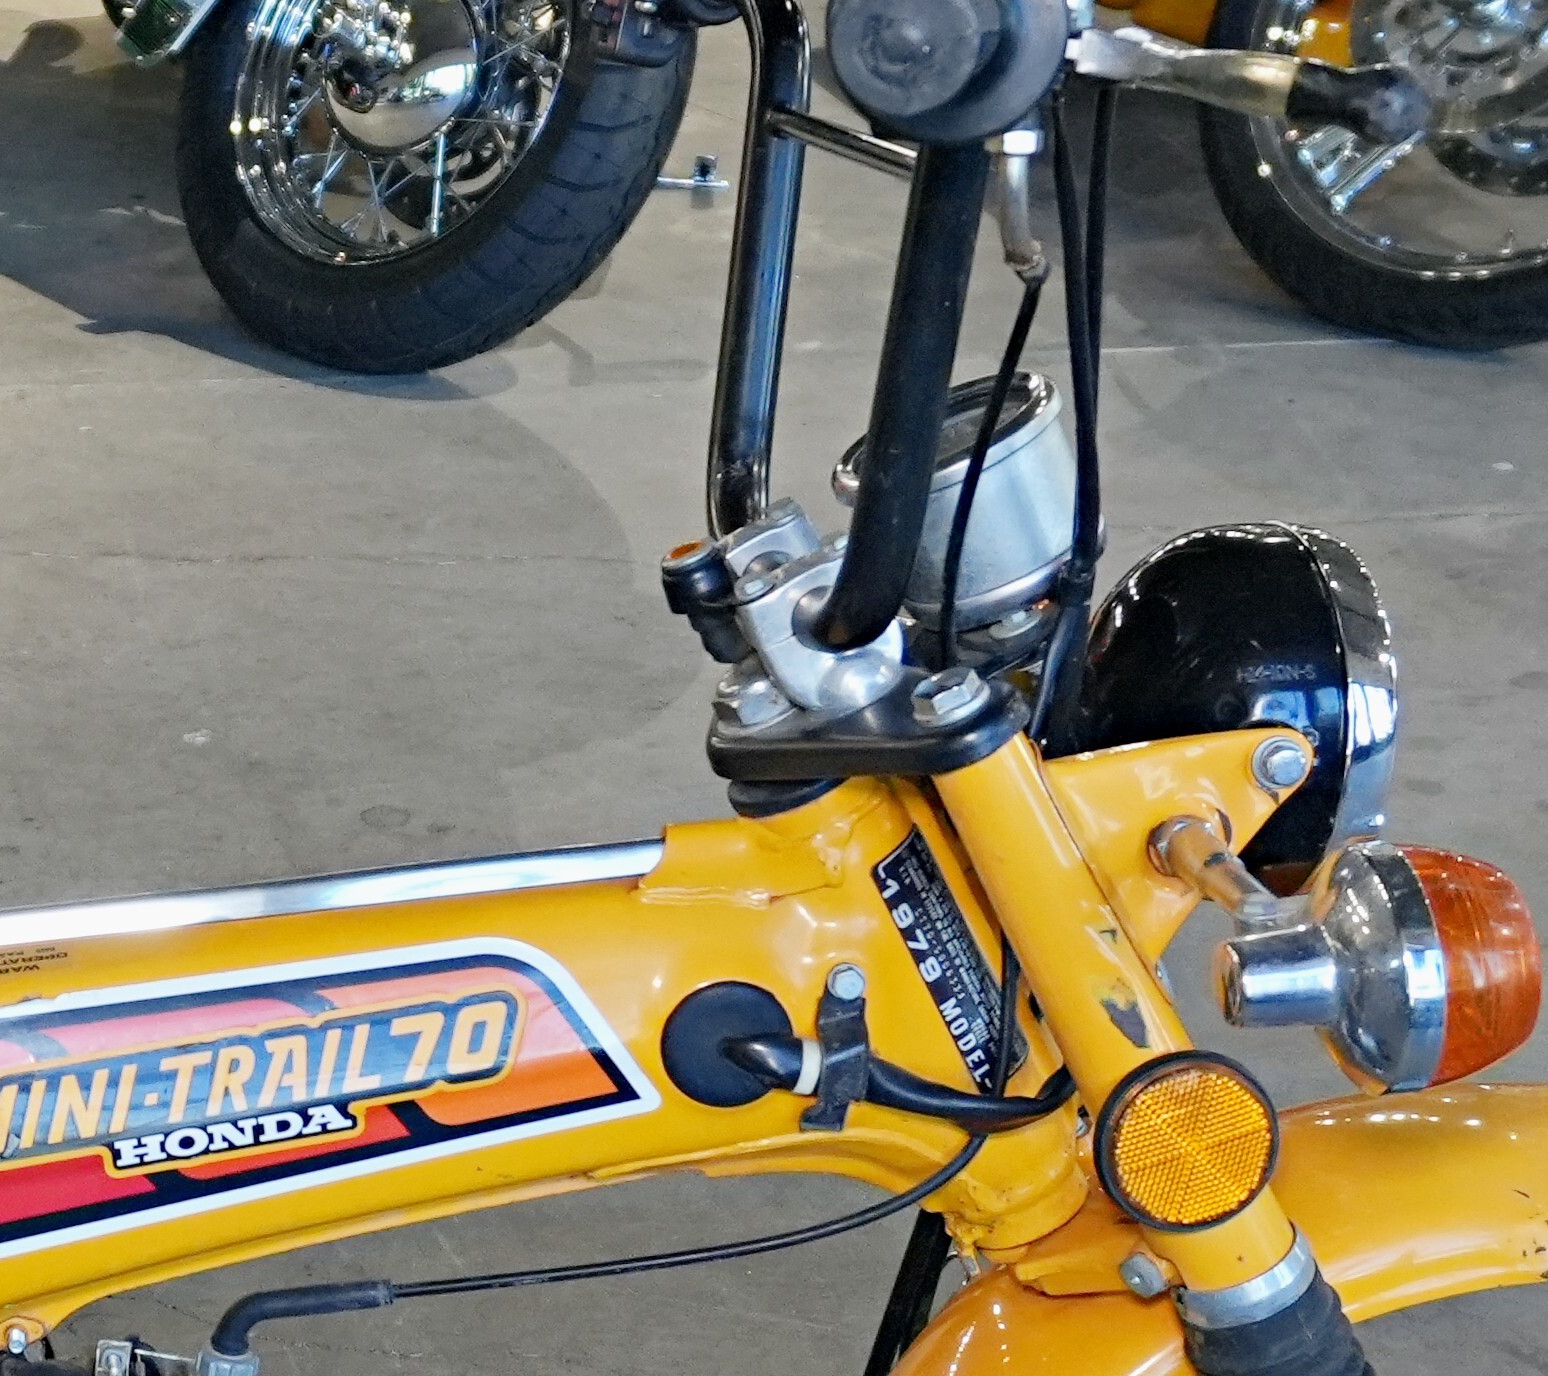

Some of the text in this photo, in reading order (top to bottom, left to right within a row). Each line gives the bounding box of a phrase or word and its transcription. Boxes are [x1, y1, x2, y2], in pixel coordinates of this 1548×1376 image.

[880, 875, 944, 984] 1979
[938, 996, 991, 1084] MODEL
[388, 999, 510, 1083] 70
[115, 1103, 355, 1167] HONDA
